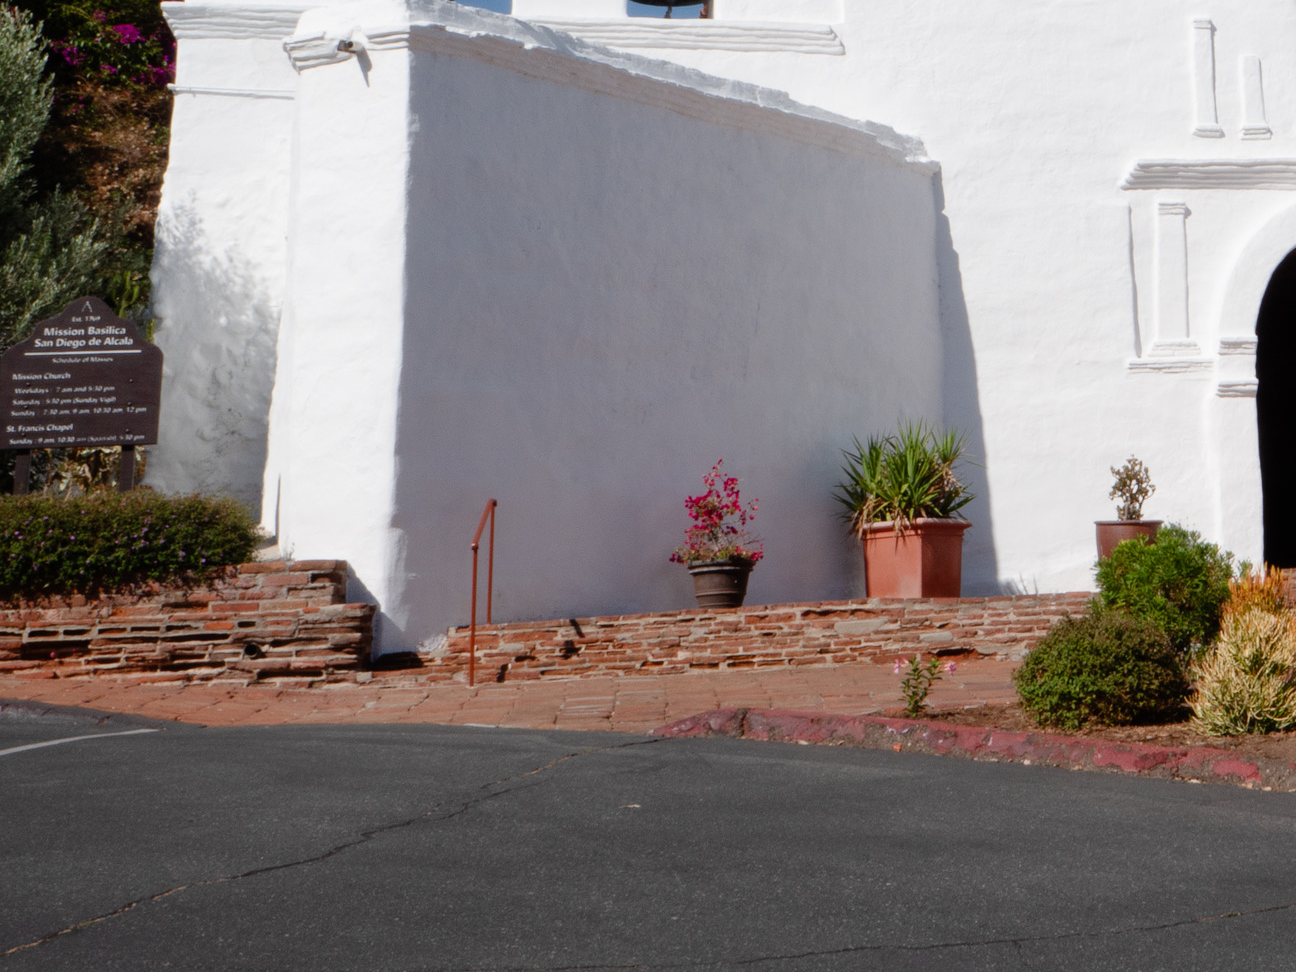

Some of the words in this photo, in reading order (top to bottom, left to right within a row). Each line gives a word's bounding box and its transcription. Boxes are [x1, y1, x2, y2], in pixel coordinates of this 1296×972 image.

[43, 327, 85, 336] Mission
[88, 325, 127, 335] Basilica
[34, 338, 54, 348] San
[56, 337, 87, 349] Diego
[88, 337, 102, 346] de
[12, 373, 43, 381] Mission
[43, 372, 71, 380] Church
[6, 424, 16, 433] St.
[18, 424, 45, 432] Francis
[46, 423, 74, 432] Chapel
